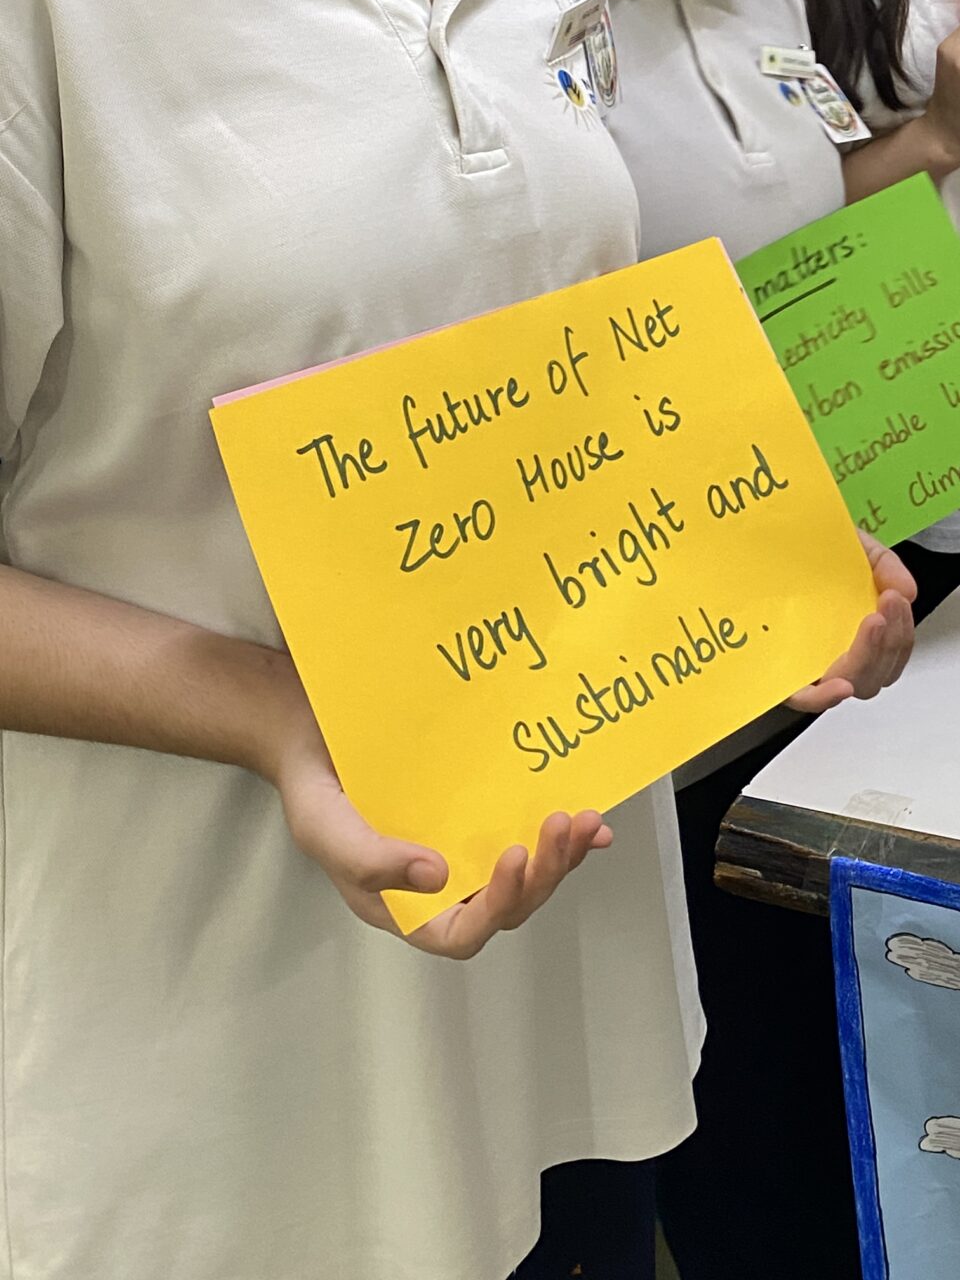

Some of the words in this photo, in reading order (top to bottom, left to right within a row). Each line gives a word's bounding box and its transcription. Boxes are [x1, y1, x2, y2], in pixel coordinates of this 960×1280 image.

[879, 267, 939, 309] bills
[296, 433, 388, 499] The
[404, 376, 530, 470] future
[547, 327, 590, 397] of
[611, 298, 681, 363] Net
[803, 378, 863, 424] rbon
[517, 428, 625, 503] House
[633, 394, 681, 435] is
[835, 413, 928, 486] stainable
[858, 499, 889, 535] at
[437, 606, 547, 682] very
[544, 489, 686, 610] bright
[706, 443, 789, 520] and
